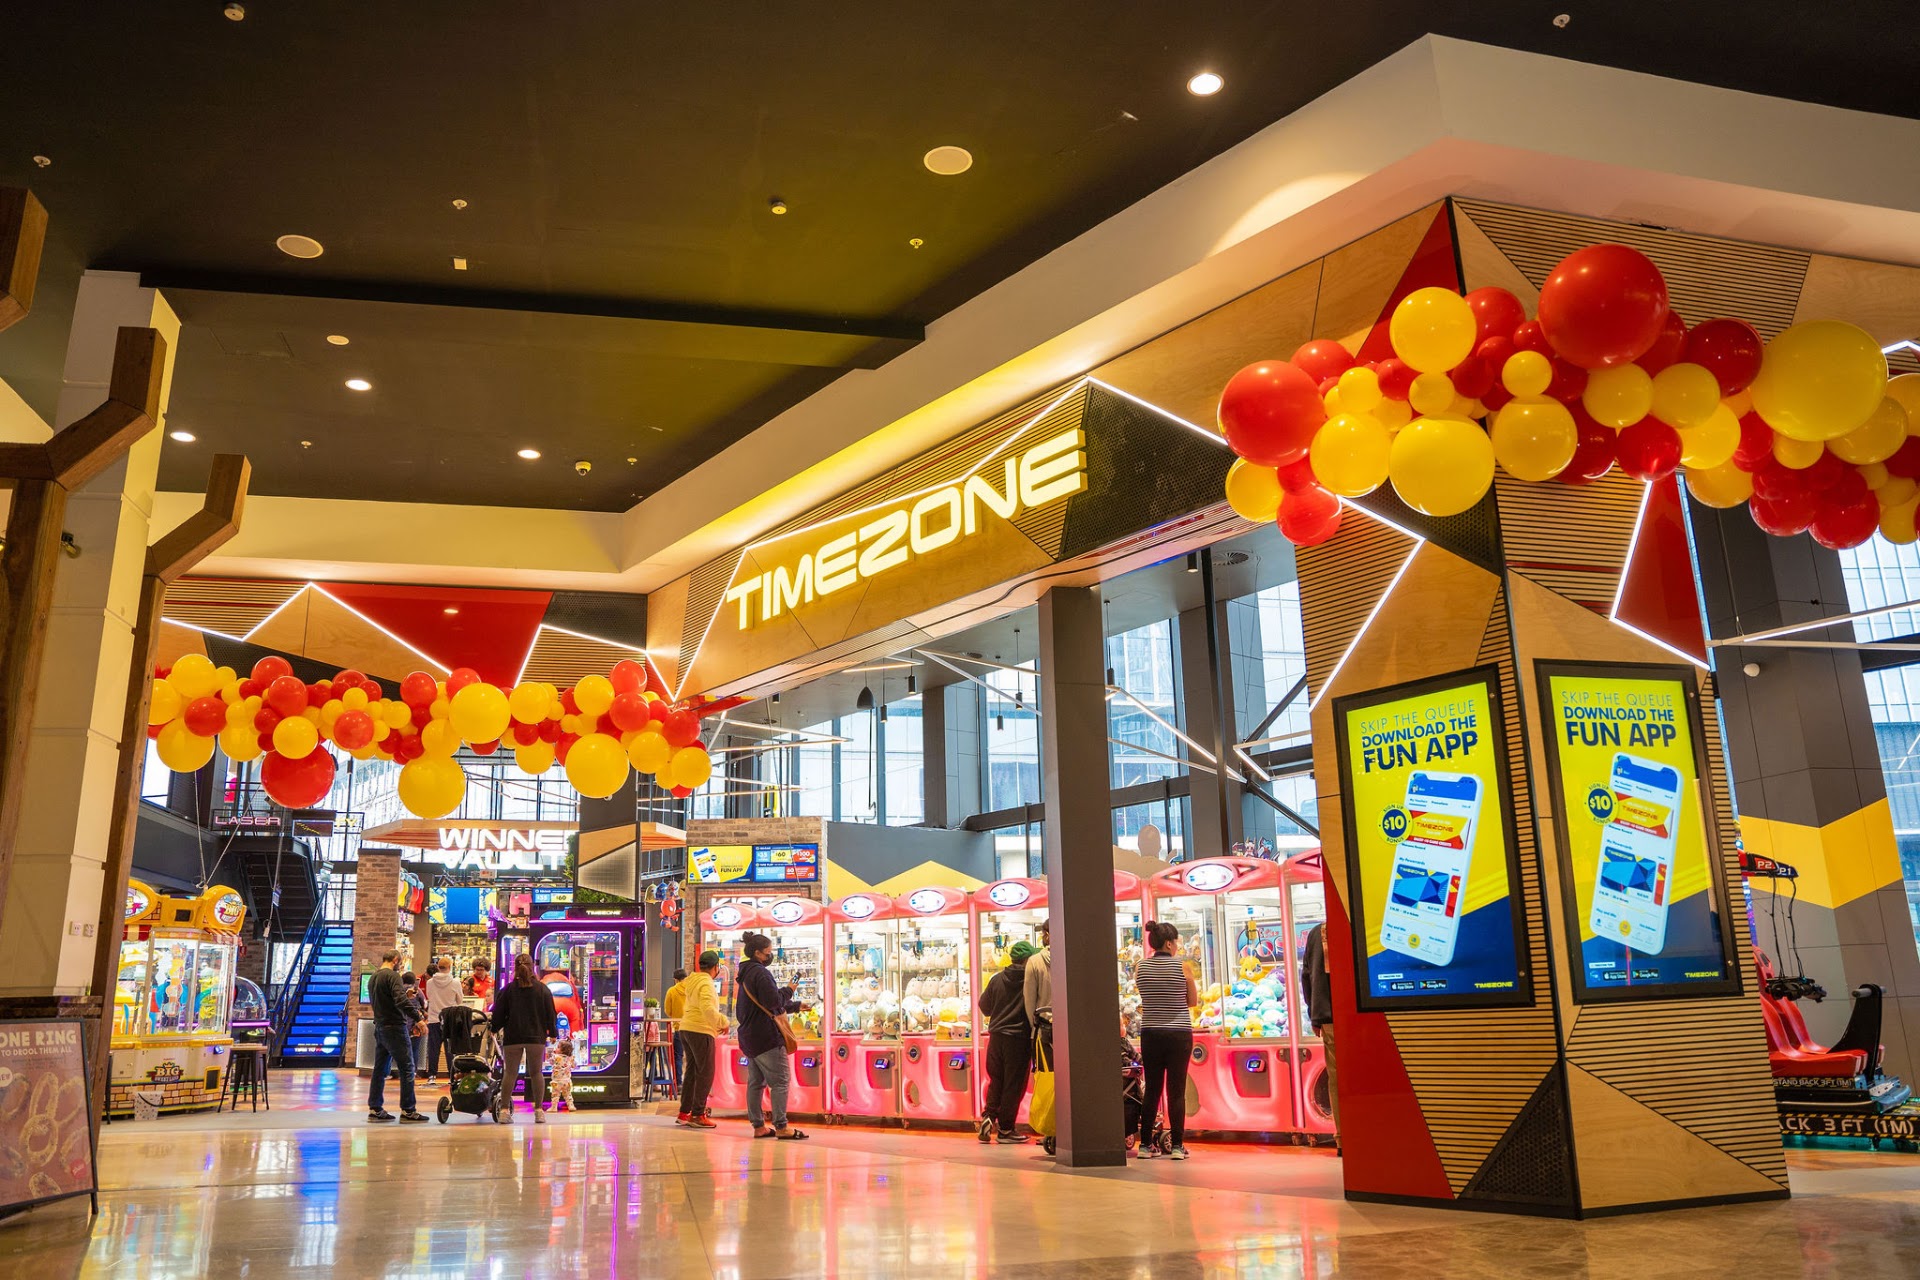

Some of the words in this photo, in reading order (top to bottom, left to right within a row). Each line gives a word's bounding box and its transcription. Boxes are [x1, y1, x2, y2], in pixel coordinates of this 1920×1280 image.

[726, 428, 1087, 631] TIMEZONE
[1560, 691, 1590, 704] SKIP
[1595, 692, 1620, 705] THE
[1626, 693, 1673, 707] QUEUE
[1360, 717, 1388, 735] SKIP
[1394, 711, 1418, 726] THE
[1425, 699, 1475, 721] QUEUE
[1563, 706, 1646, 721] DOWNLOAD
[1649, 708, 1674, 722] THE
[1363, 721, 1446, 748] DOWNLOAD
[1449, 714, 1477, 731] THE
[1565, 721, 1621, 747] FUN
[1629, 723, 1676, 747] APP
[1363, 741, 1418, 773] FUN
[1425, 730, 1478, 763] APP
[1383, 804, 1395, 812] SIGN
[1590, 795, 1611, 810] $10
[1622, 805, 1658, 820] TIMEZONE
[214, 815, 281, 826] LASER
[1384, 815, 1405, 831] $10
[1416, 822, 1454, 833] TIMEZONE
[1757, 860, 1772, 869] P2
[1779, 867, 1791, 876] P1
[1684, 971, 1719, 979] TIMEZONE
[1474, 981, 1514, 989] TIMEZONE
[0, 1031, 30, 1048] ONE
[36, 1029, 77, 1046] RING
[1, 1049, 11, 1057] TO
[13, 1047, 38, 1056] DROOL
[40, 1046, 59, 1055] THEM
[155, 1066, 180, 1077] BIG
[1836, 1079, 1852, 1087] (1M)
[1874, 1119, 1914, 1135] (1M)
